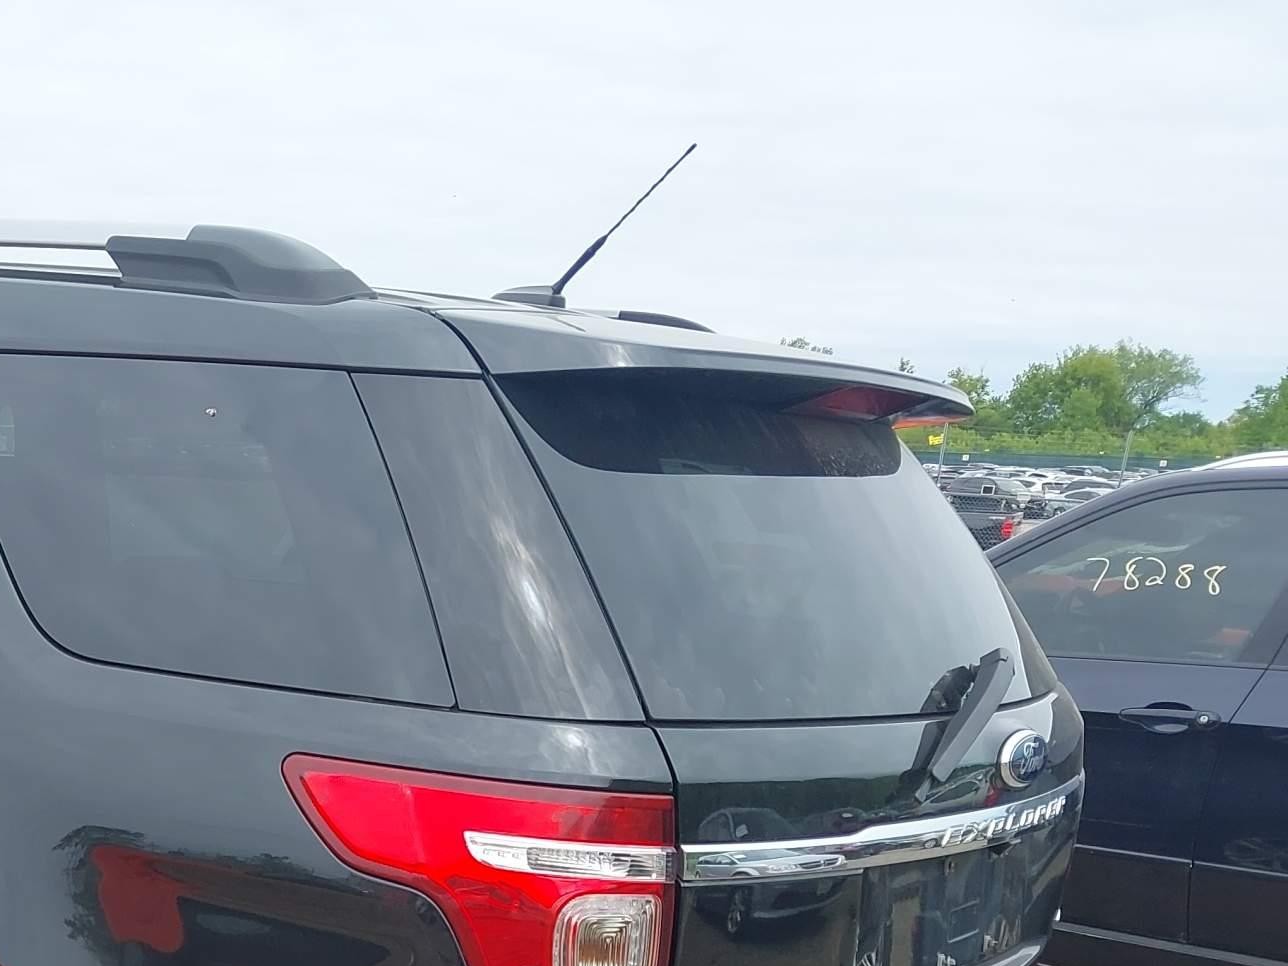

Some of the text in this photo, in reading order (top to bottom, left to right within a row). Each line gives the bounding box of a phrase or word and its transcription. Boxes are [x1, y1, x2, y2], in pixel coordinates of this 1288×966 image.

[1087, 556, 1227, 596] 78288
[1016, 741, 1043, 775] Ford
[940, 795, 1067, 848] EXPLORER
